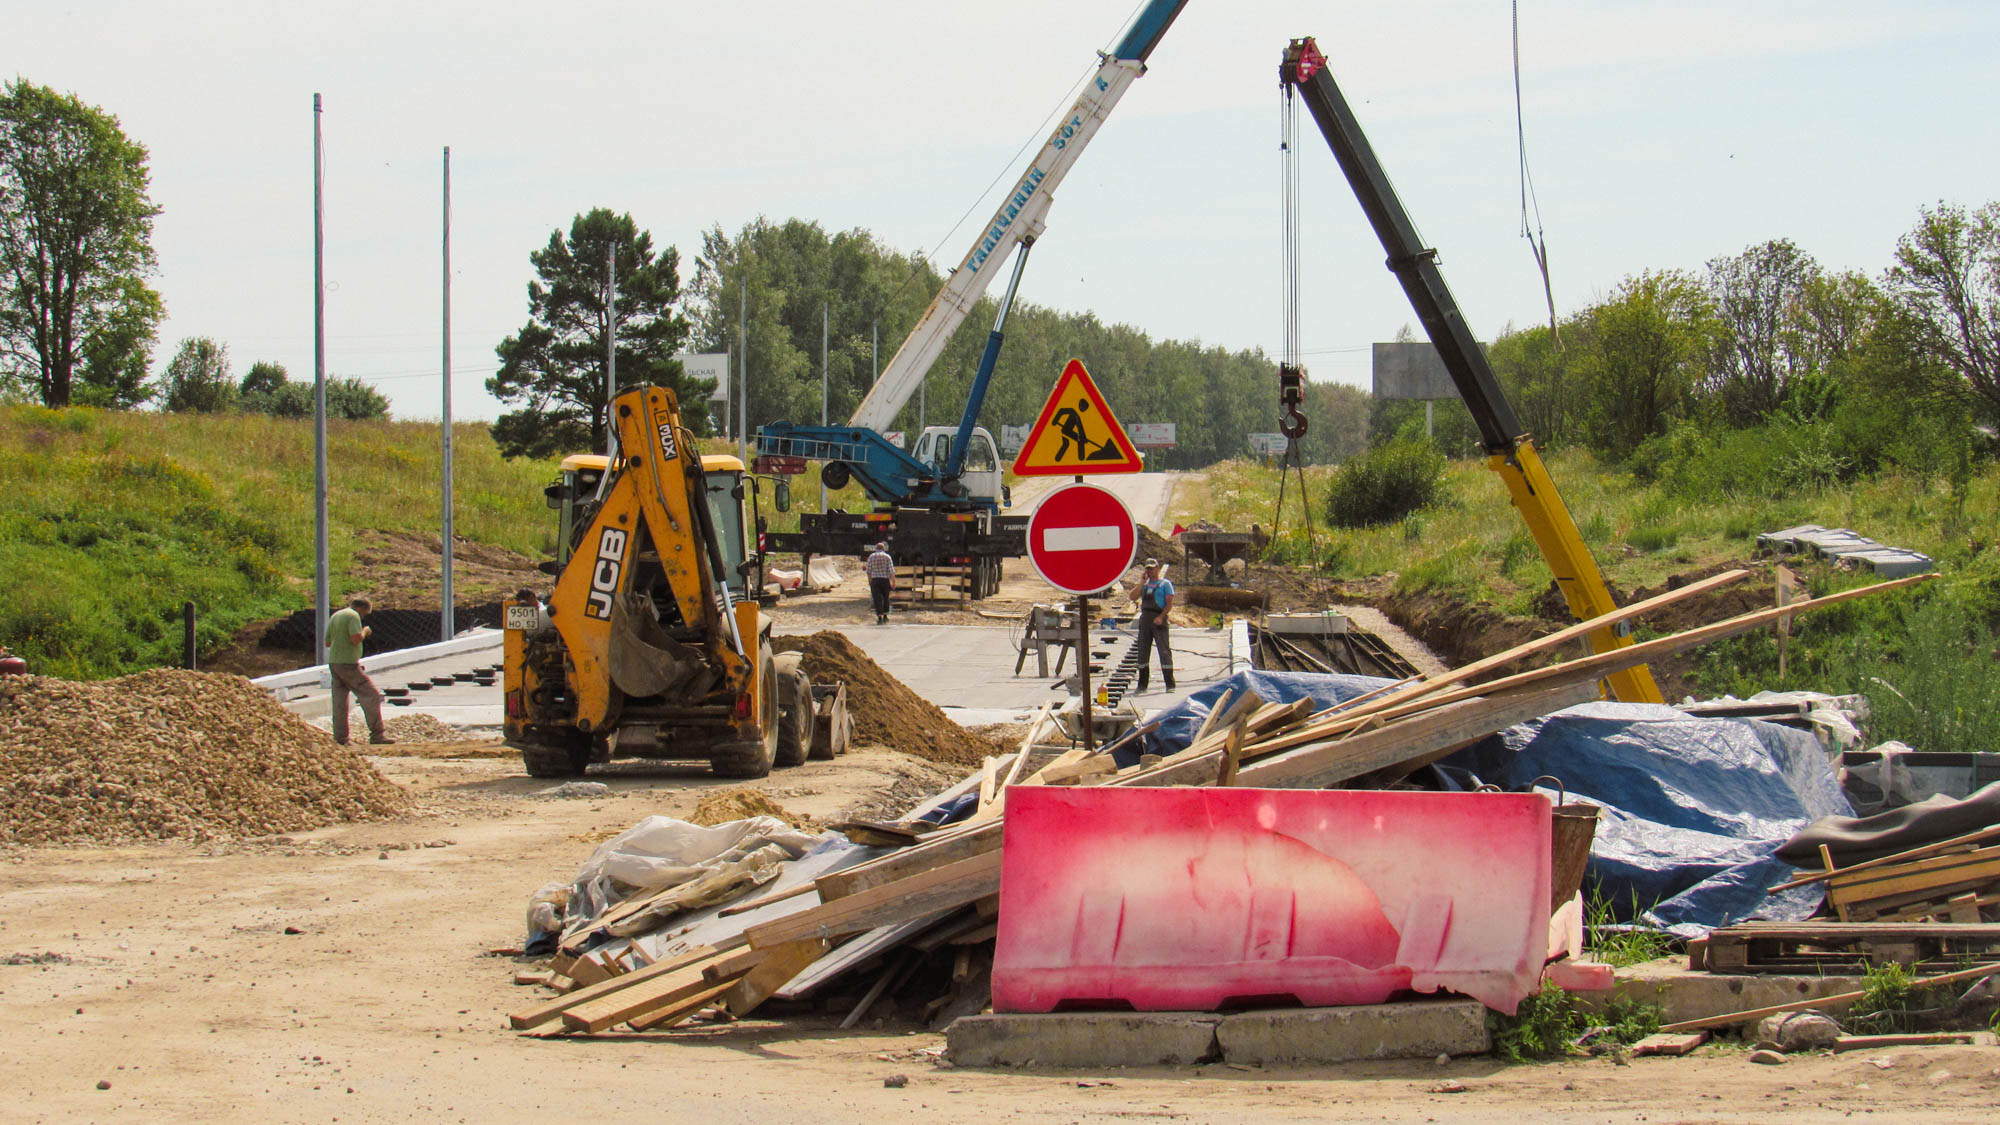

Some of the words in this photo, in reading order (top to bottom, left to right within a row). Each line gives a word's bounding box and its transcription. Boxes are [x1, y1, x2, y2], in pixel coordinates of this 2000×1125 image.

[659, 424, 677, 457] 3CX
[590, 529, 626, 618] JCB
[510, 608, 535, 618] 9501
